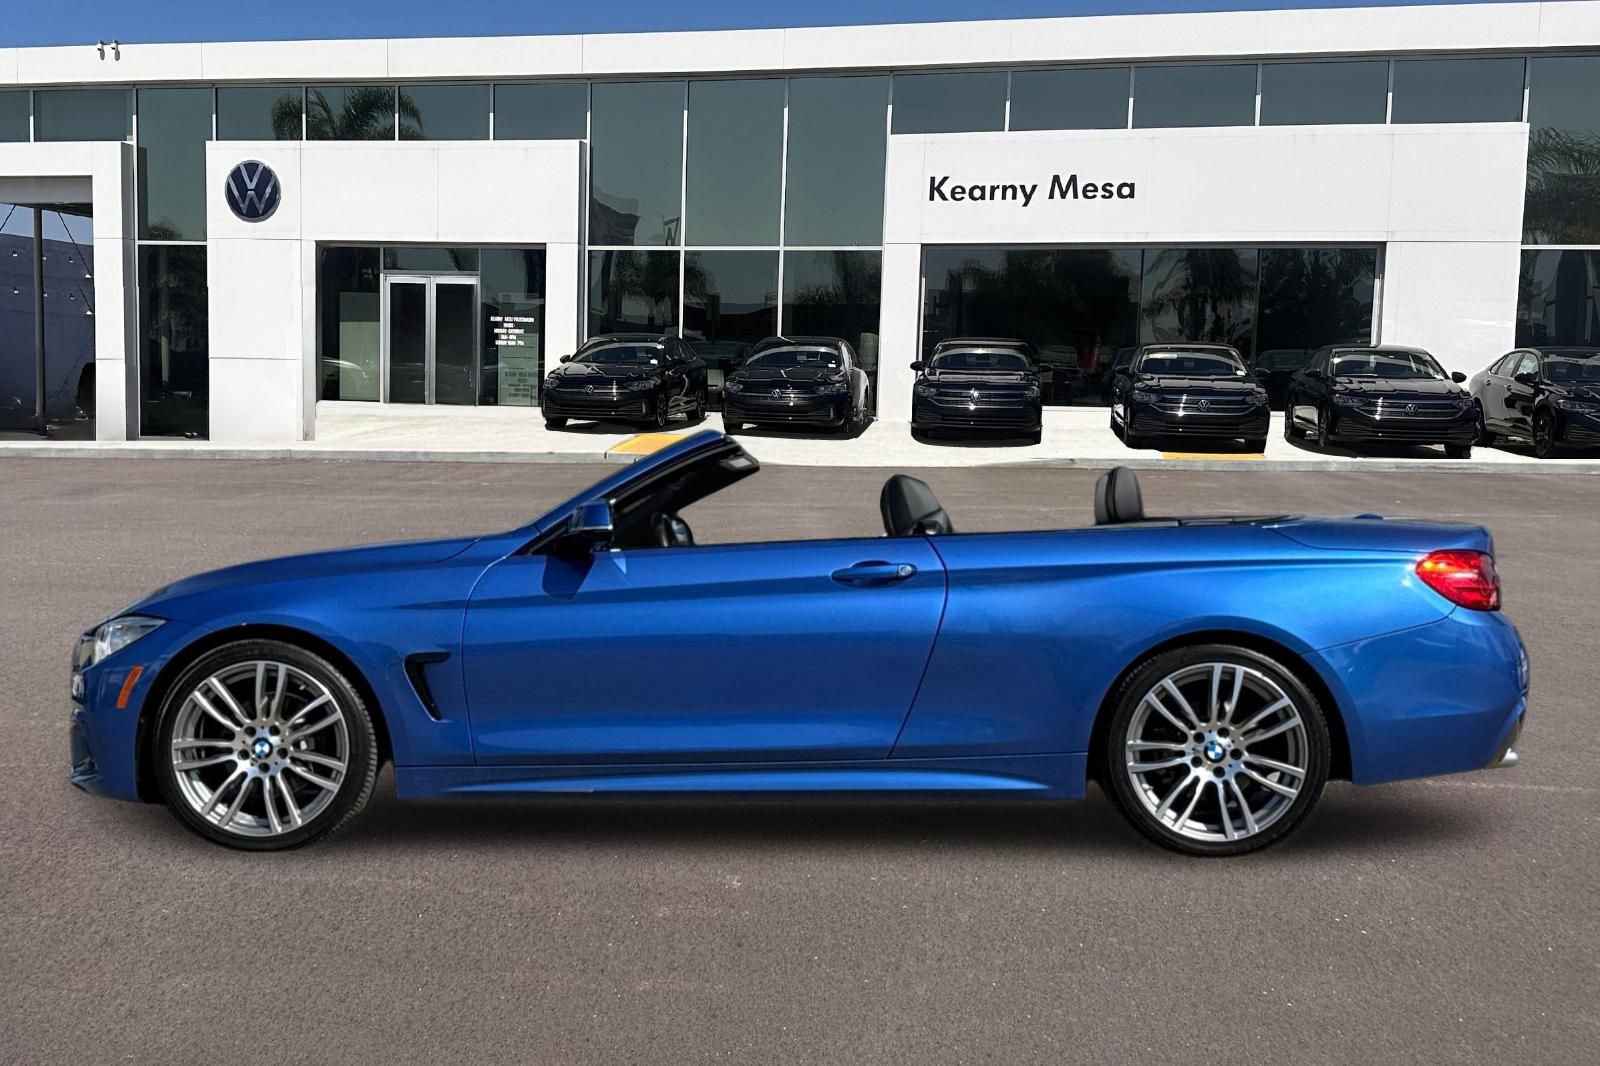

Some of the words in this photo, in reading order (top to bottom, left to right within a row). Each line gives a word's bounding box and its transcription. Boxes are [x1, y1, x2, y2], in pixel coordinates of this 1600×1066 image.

[227, 162, 278, 218] VW
[929, 176, 1038, 207] Kearny
[1048, 174, 1136, 200] Mesa
